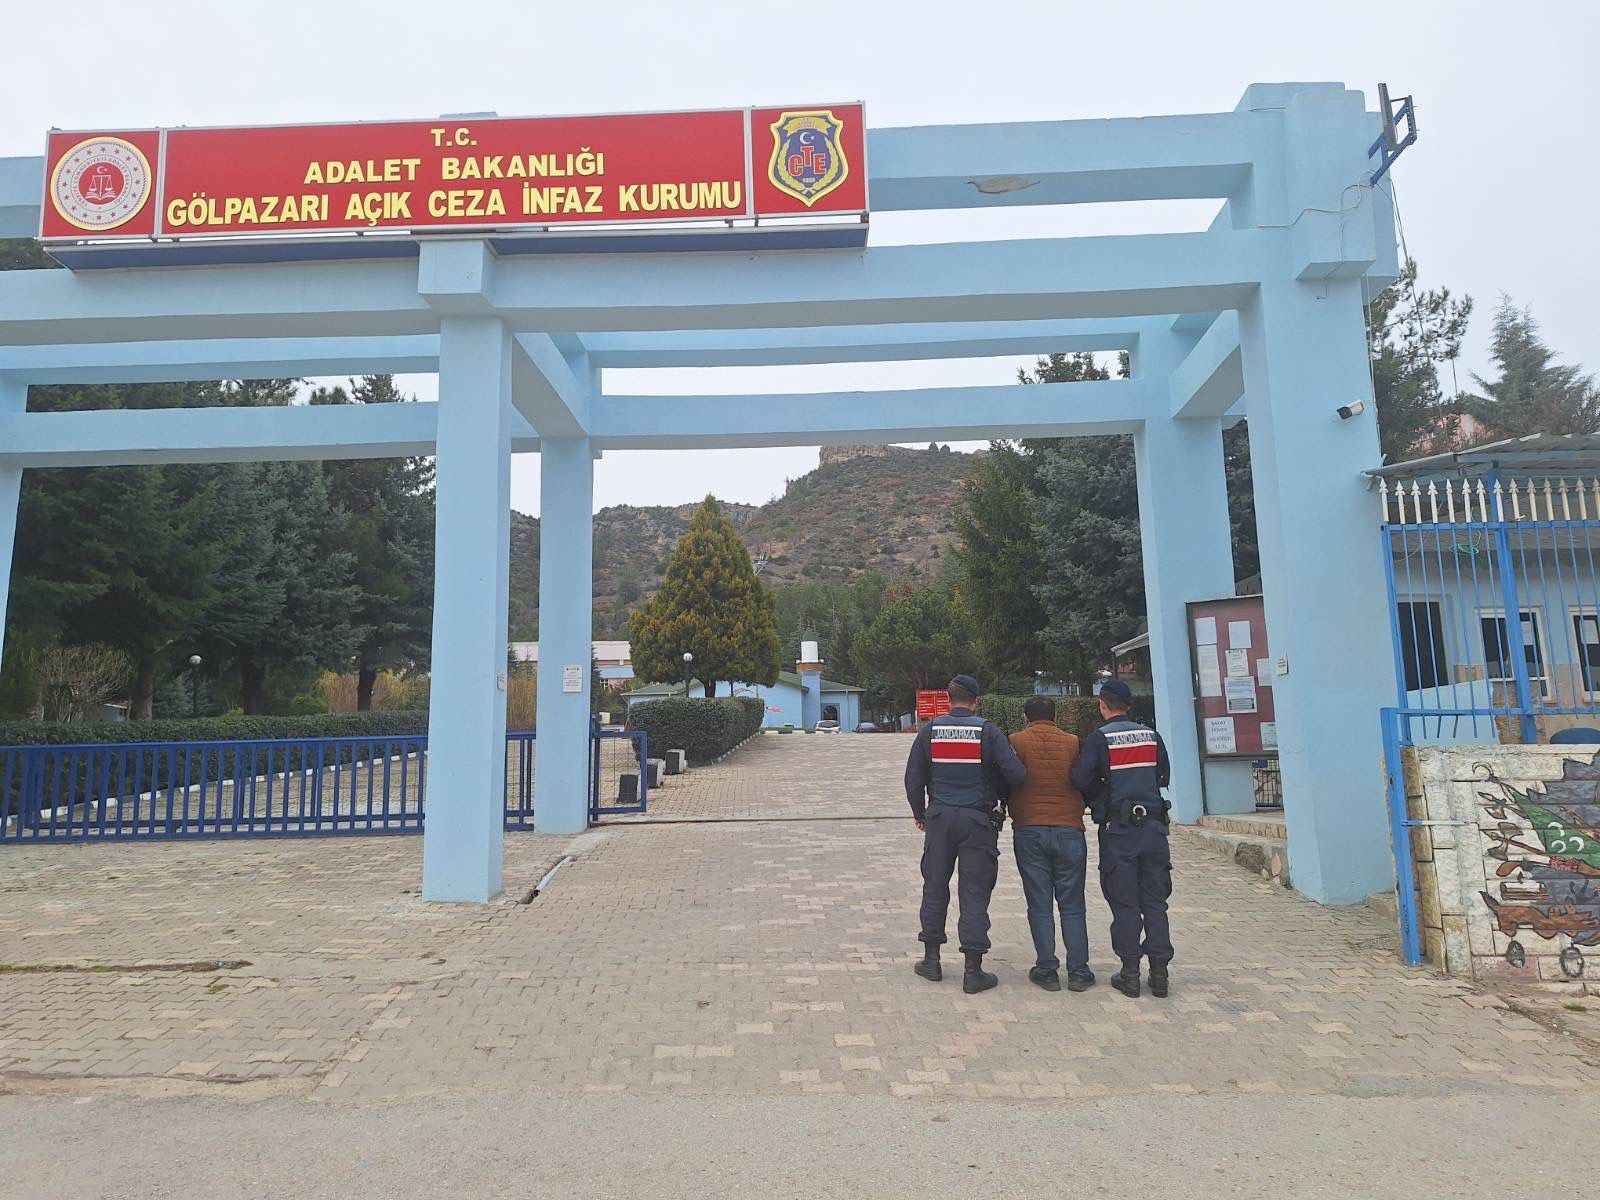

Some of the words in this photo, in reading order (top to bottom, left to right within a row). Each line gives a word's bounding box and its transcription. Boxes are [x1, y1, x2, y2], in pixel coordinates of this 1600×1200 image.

[431, 127, 477, 147] T.C.
[303, 158, 421, 185] ADALET
[441, 146, 605, 180] BAKANLIĞI
[788, 145, 827, 177] CTE
[167, 192, 329, 227] GÖLPAZARI
[344, 191, 412, 227] AÇIK
[428, 188, 506, 217] CEZA
[522, 181, 603, 215] İNFAZ
[619, 180, 741, 212] KURUMU
[934, 728, 977, 740] JANDARMA
[1111, 733, 1153, 745] JANDARMA
